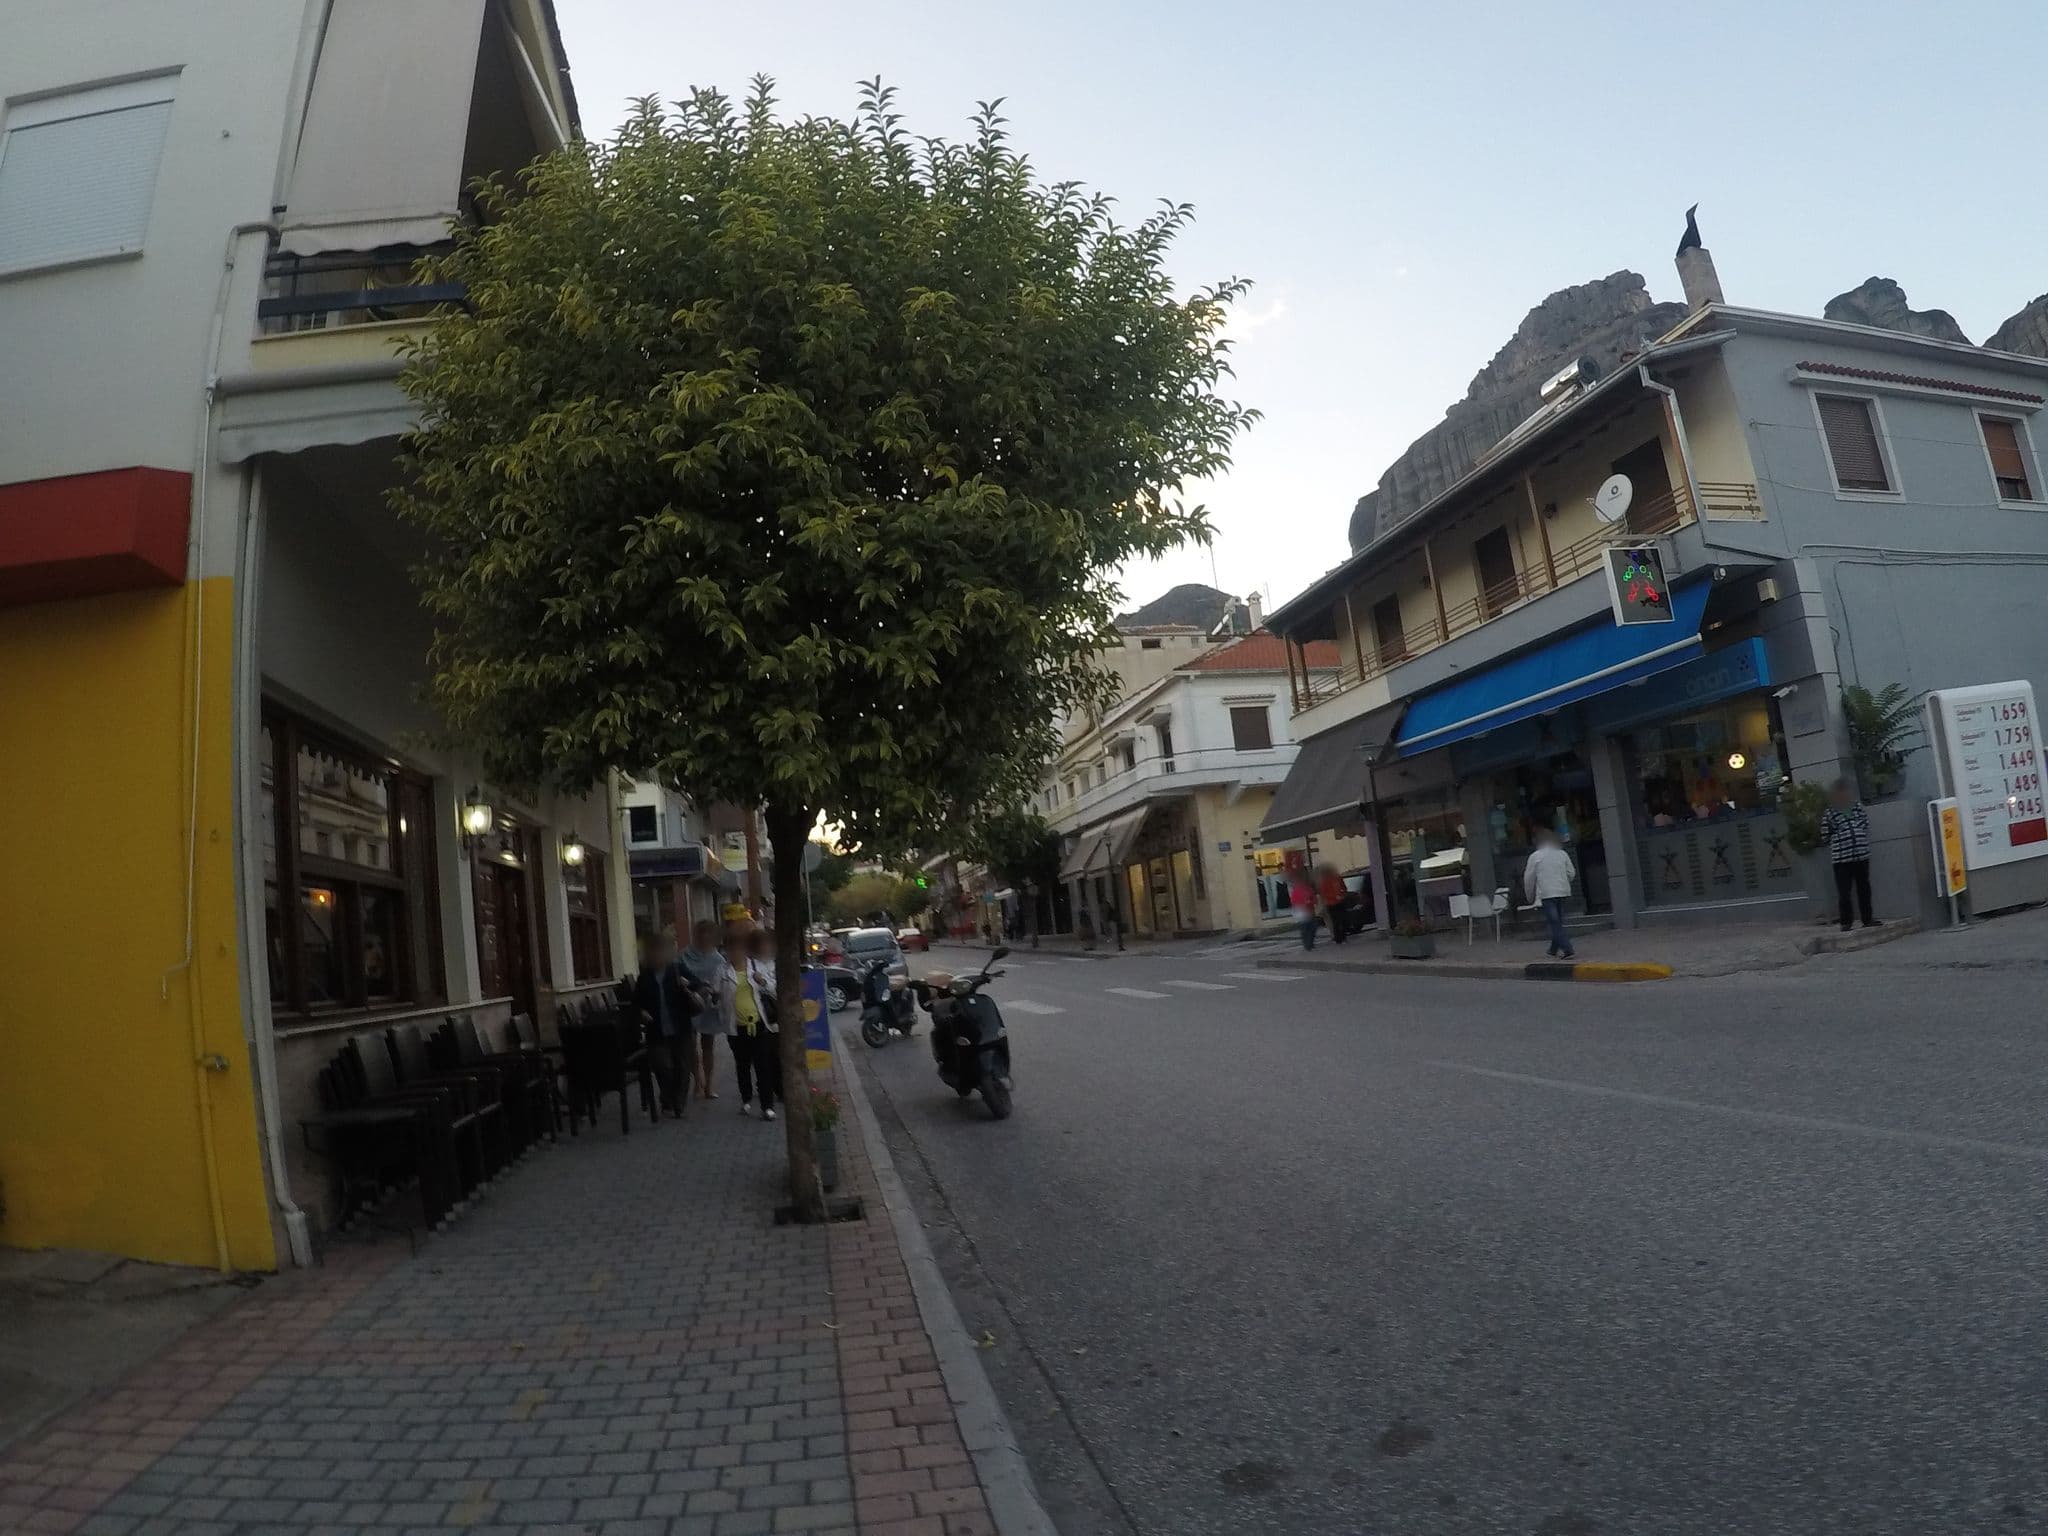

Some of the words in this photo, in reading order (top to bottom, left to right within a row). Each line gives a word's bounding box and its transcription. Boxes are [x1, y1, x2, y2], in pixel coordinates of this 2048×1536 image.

[1990, 702, 2026, 722] 1.659
[1994, 725, 2030, 746] 1.759
[1999, 749, 2034, 770] 1.449
[2003, 773, 2038, 796] 1.489
